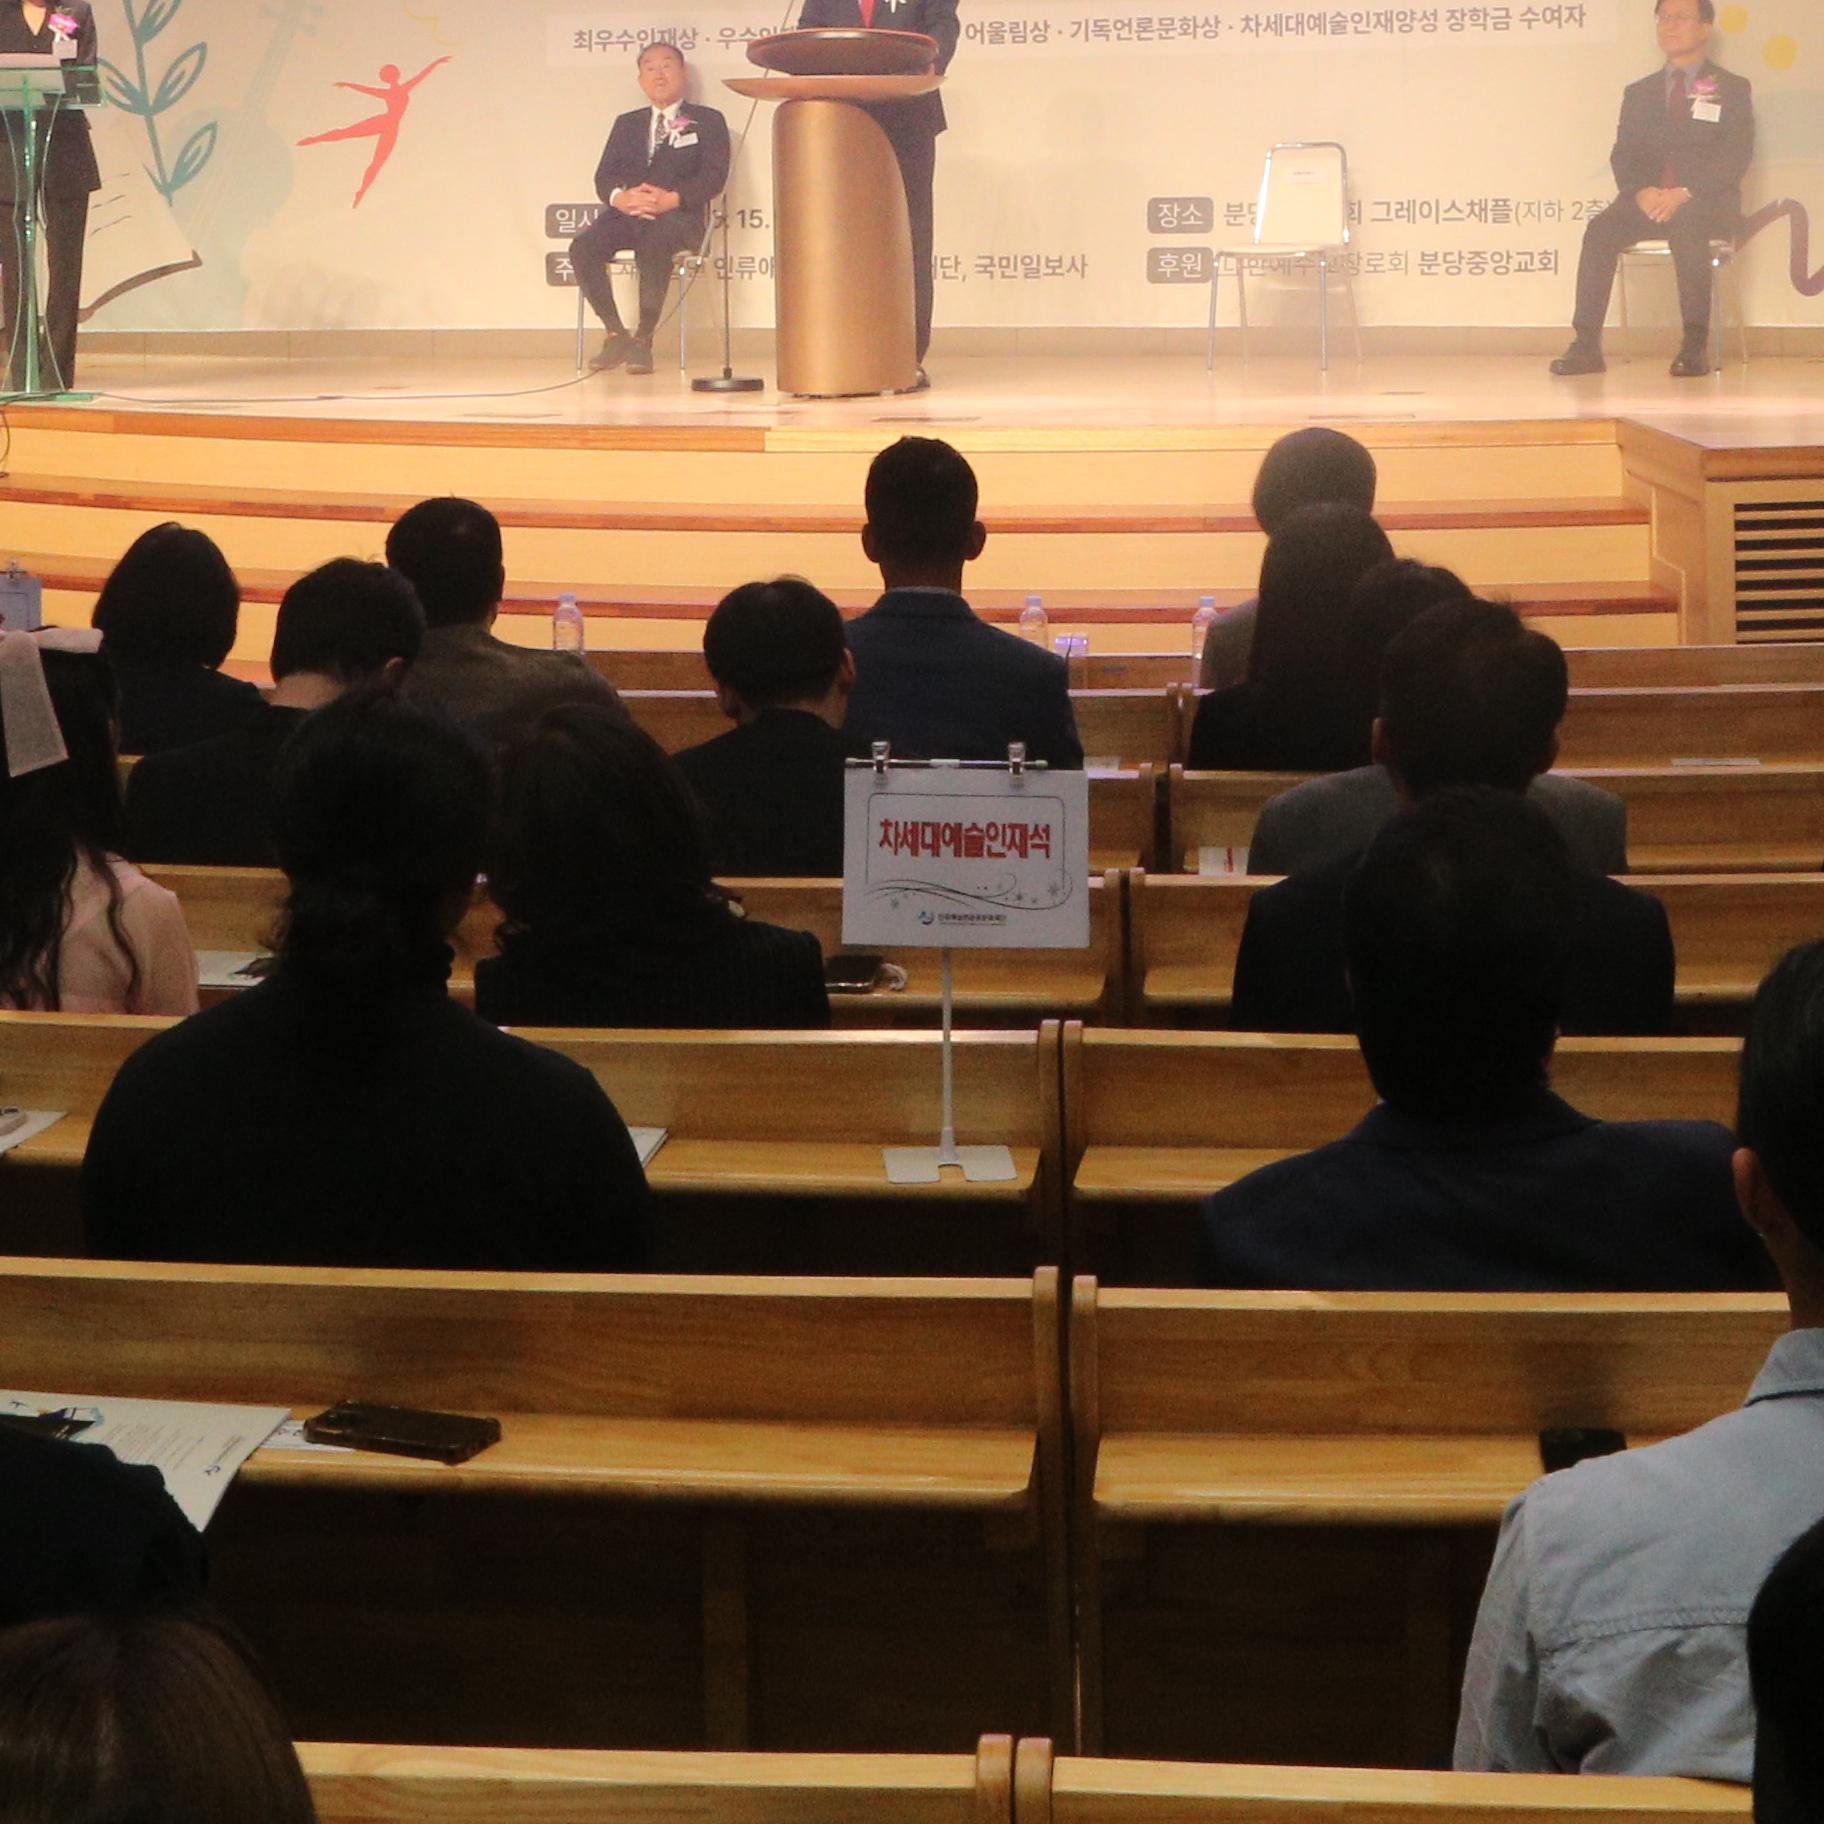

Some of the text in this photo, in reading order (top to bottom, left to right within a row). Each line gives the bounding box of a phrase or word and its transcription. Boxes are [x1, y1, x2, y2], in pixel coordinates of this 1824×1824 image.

[965, 19, 1051, 45] 어울림상
[1070, 12, 1220, 44] 기독언론문화상
[1240, 8, 1439, 39] 차세대예술인재양성
[1445, 5, 1513, 33] 장학금
[1519, 3, 1587, 30] 수여자
[1157, 202, 1204, 227] 장소
[974, 253, 1088, 280] 국민일보사
[1157, 251, 1204, 276] 후원
[1418, 249, 1559, 275] 분당중앙교회
[879, 818, 1051, 859] 차세대예술인재석
